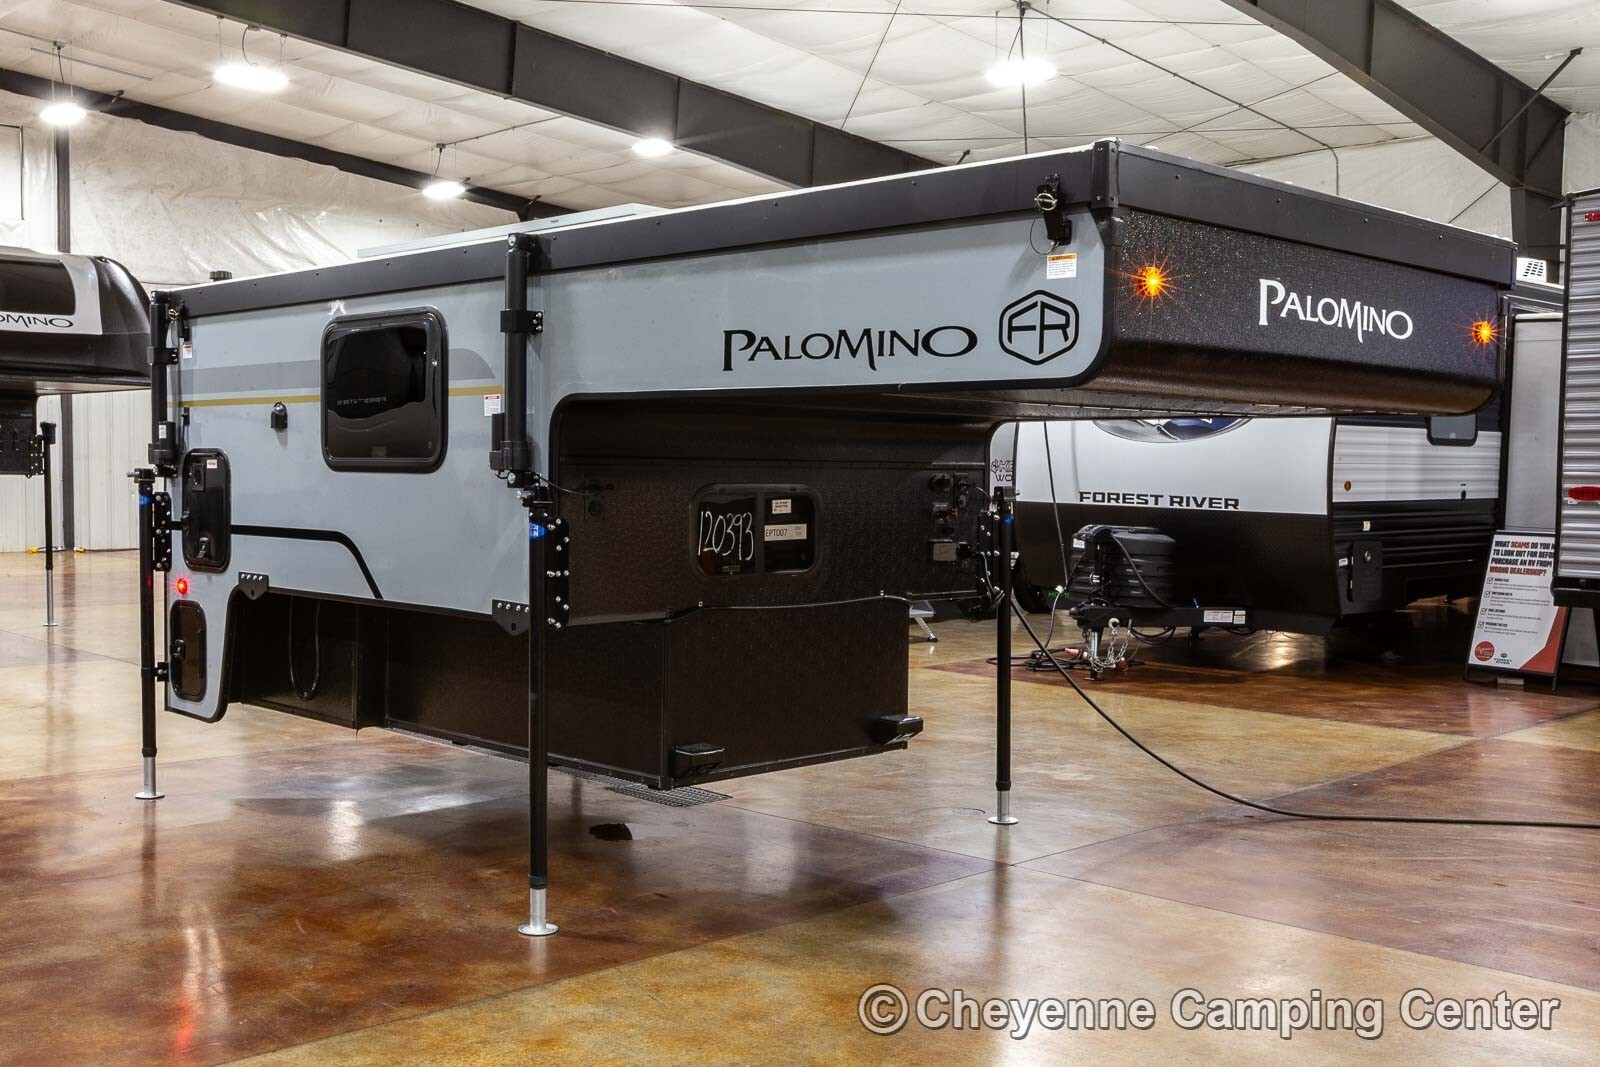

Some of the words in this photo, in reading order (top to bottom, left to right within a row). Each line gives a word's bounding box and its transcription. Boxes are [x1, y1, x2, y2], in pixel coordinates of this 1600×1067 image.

[1258, 278, 1414, 344] PALOMINO
[722, 325, 978, 371] PALOMINO
[1079, 491, 1164, 506] FOREST
[1168, 495, 1239, 510] RIVER
[697, 510, 754, 561] 120393
[1511, 541, 1530, 549] SCAMS
[1501, 549, 1515, 557] LOOK
[1491, 558, 1519, 566] PURCHASE
[1509, 567, 1547, 576] DEALERSHIP?
